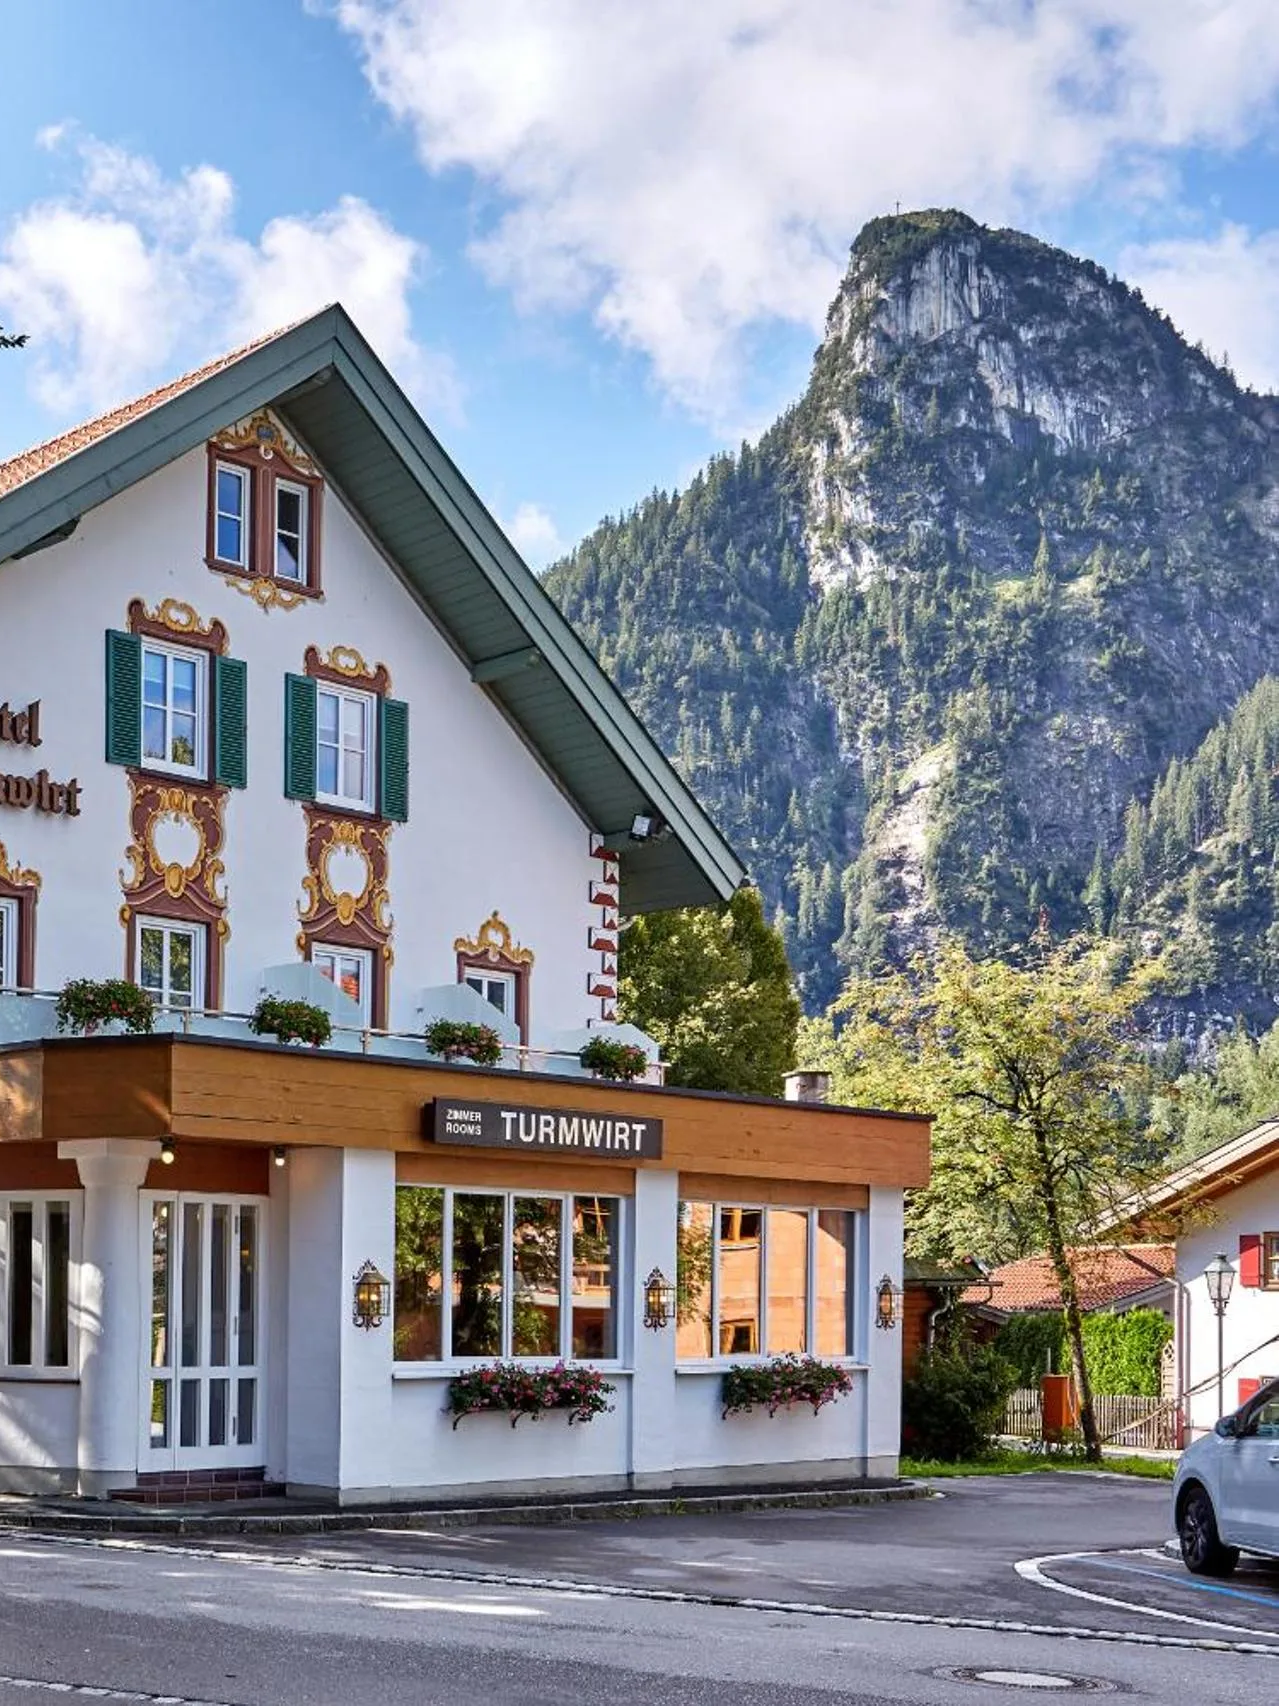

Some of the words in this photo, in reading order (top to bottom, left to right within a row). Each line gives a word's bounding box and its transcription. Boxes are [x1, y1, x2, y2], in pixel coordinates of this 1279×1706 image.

[446, 1109, 482, 1122] ZIMMER
[446, 1122, 482, 1136] ROOMS
[500, 1111, 646, 1151] TURMWIRT
